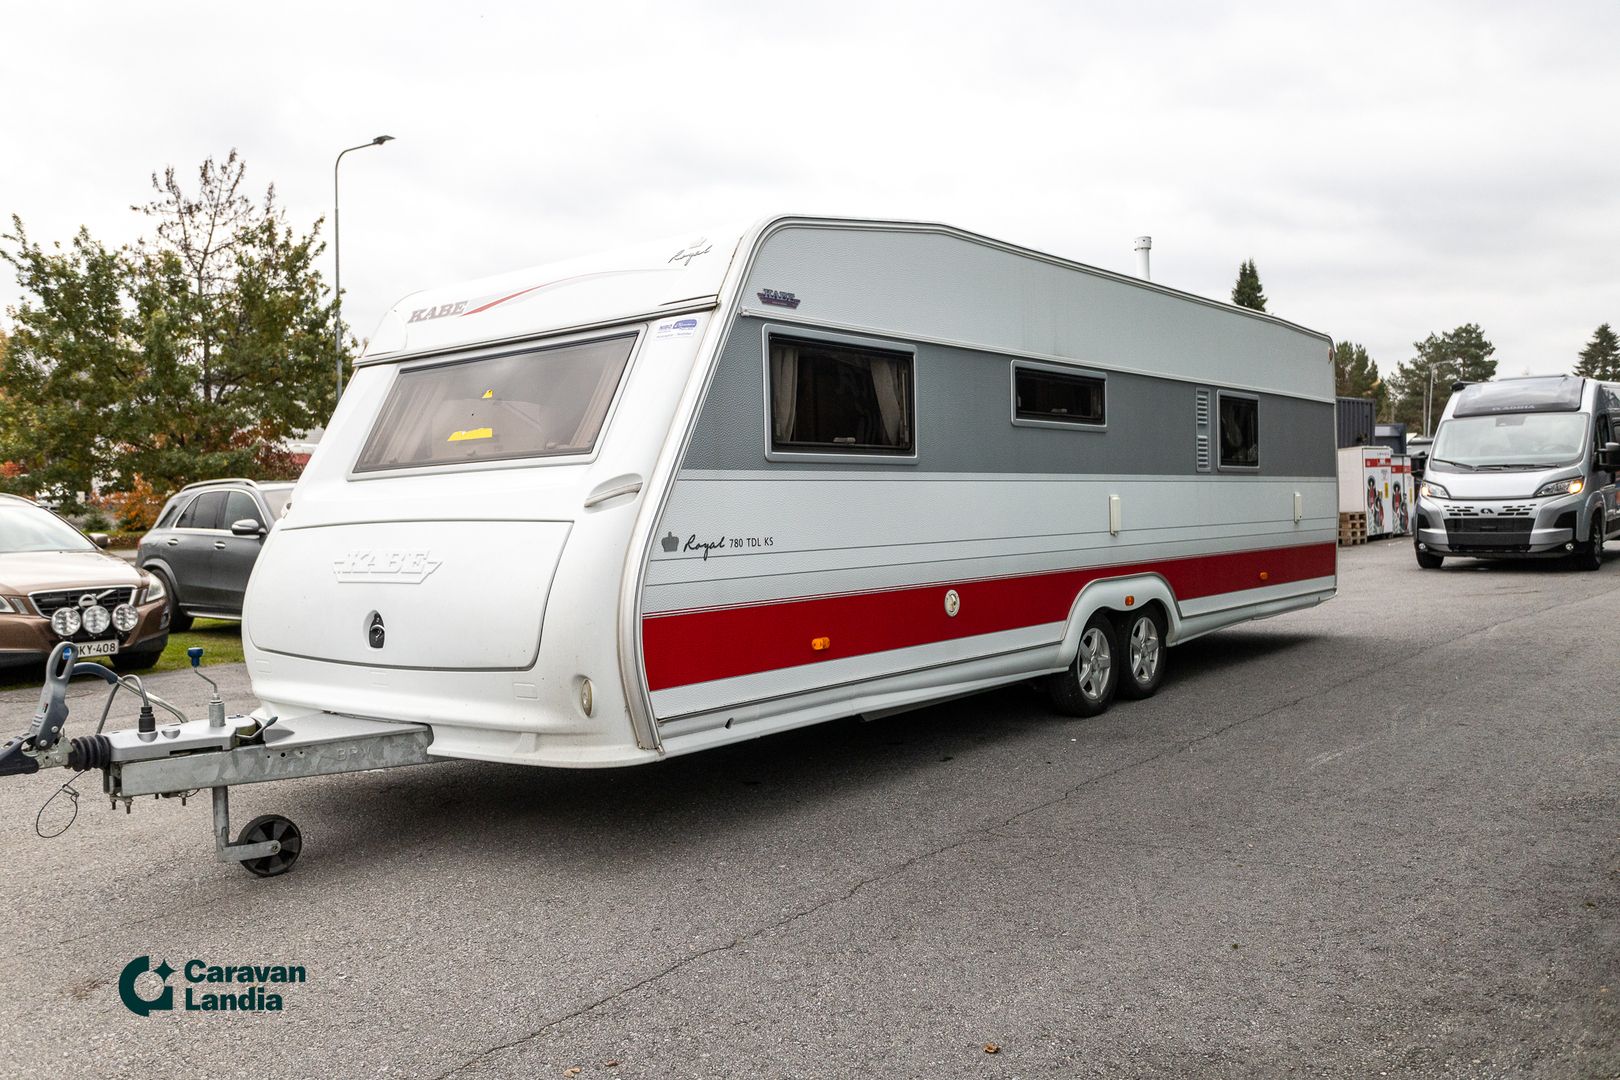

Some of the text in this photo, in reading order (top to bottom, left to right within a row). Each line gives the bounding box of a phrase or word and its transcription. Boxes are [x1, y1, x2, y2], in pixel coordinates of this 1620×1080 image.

[762, 288, 796, 302] KABE
[407, 300, 468, 324] KABE
[683, 534, 774, 561] Royal 780 TDL KS
[340, 548, 431, 574] KABE
[79, 642, 116, 656] KY-408
